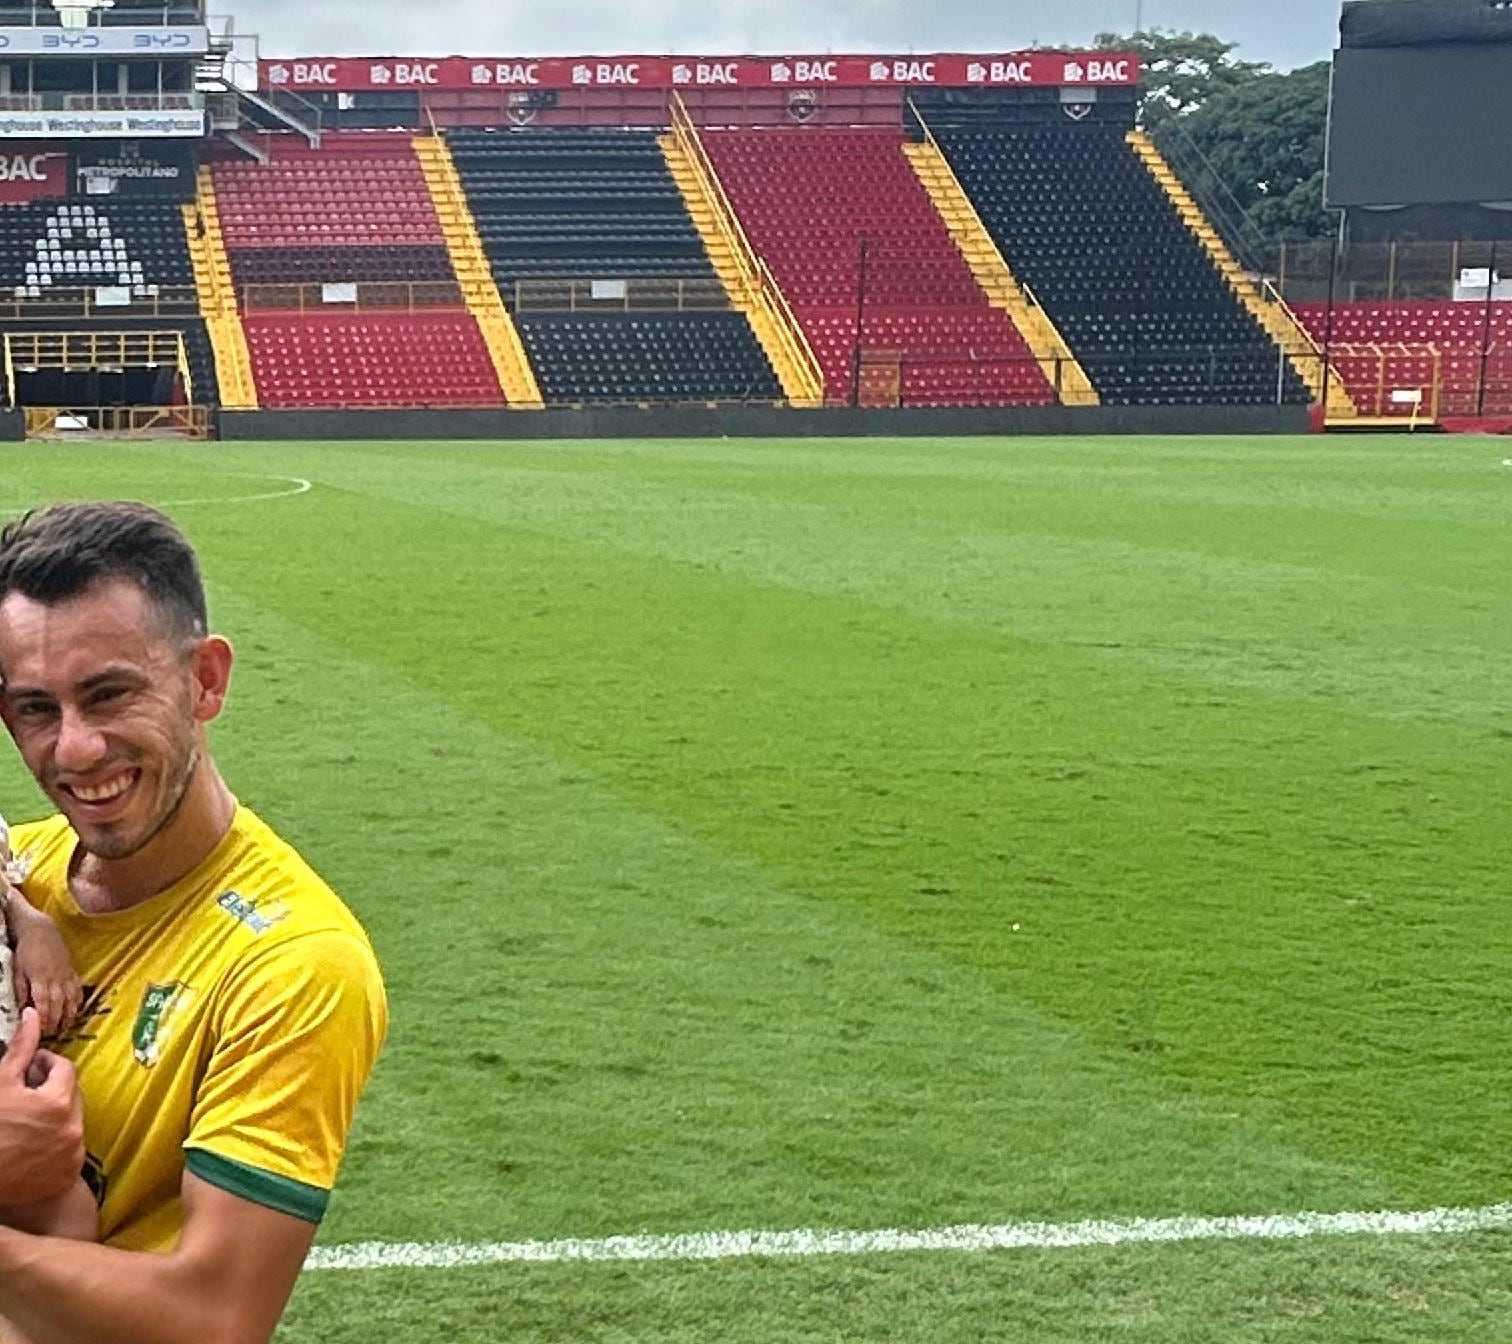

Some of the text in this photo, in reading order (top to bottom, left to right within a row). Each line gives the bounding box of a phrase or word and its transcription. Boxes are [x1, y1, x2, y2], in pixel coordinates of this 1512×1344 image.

[42, 34, 100, 48] BYD
[134, 33, 190, 48] BYD
[293, 61, 1129, 84] BAC BAC BAC BAC BAC BAC BAC BAC BAC
[15, 205, 159, 297] A
